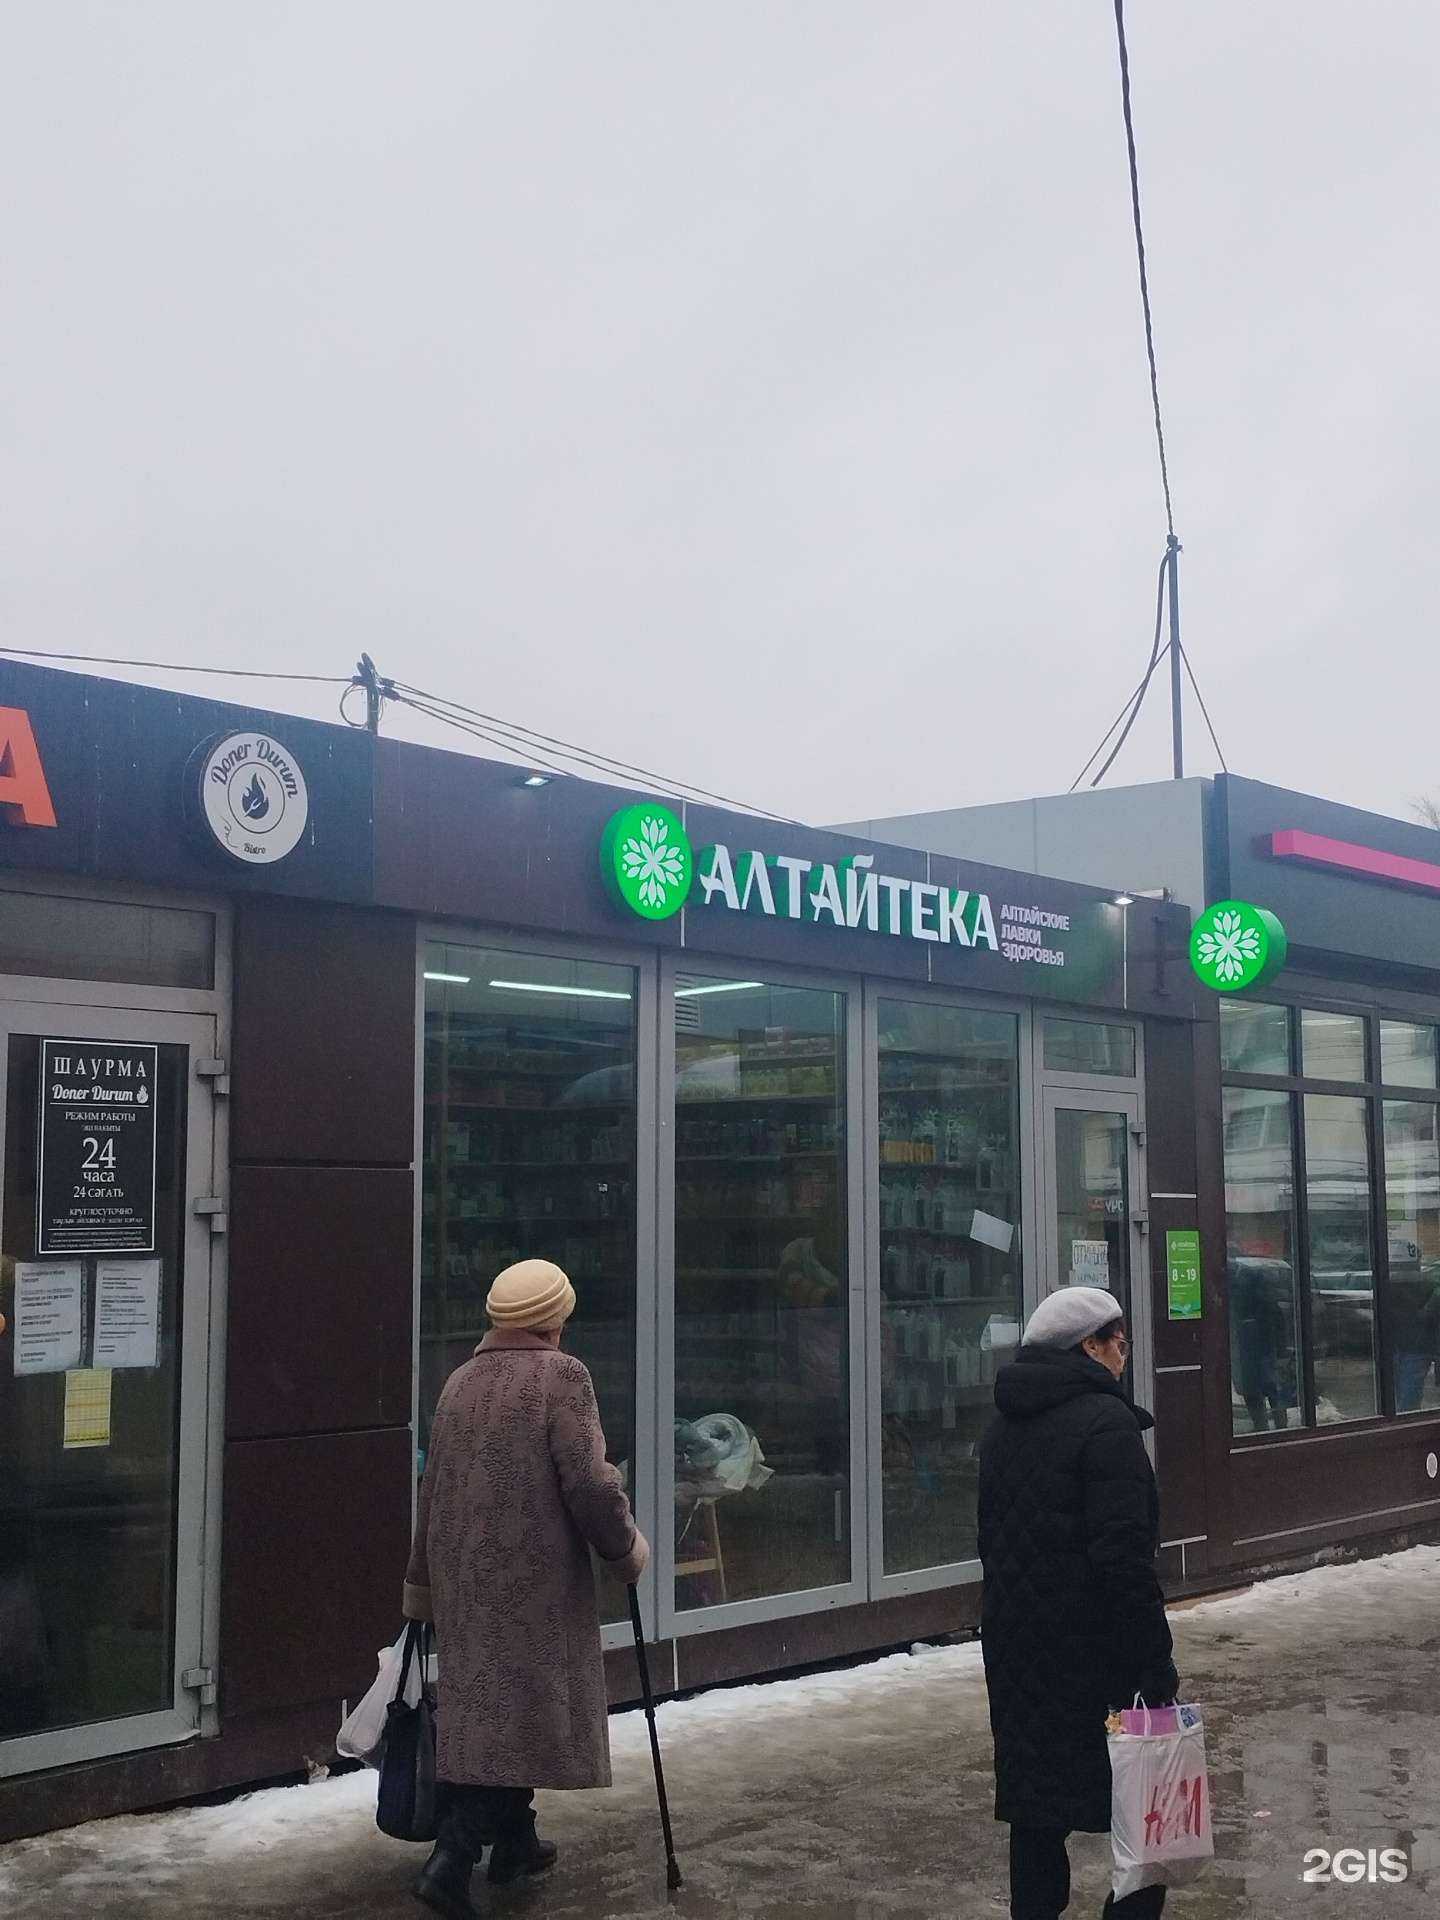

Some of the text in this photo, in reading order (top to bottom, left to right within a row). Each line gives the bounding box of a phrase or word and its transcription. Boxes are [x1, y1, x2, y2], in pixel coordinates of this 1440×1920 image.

[210, 738, 298, 799] Doner Durum
[699, 843, 1000, 952] АЛТАЙТЕКА
[1000, 904, 1070, 931] АЛТАЙСКИЕ
[1001, 923, 1041, 946] ЛАВКИ
[1001, 942, 1064, 966] ЗДОРОВЬЯ
[53, 1056, 147, 1080] ШАУРМА
[52, 1084, 134, 1102] Doner Durum
[65, 1111, 136, 1122] РЕЖИМ РАБОТЫ
[81, 1136, 116, 1169] 24
[83, 1171, 115, 1183] часа
[73, 1186, 86, 1198] 24
[69, 1207, 134, 1217] КРУГЛОСУТОЧНО
[1172, 1268, 1179, 1282] 8
[1186, 1268, 1197, 1282] 19
